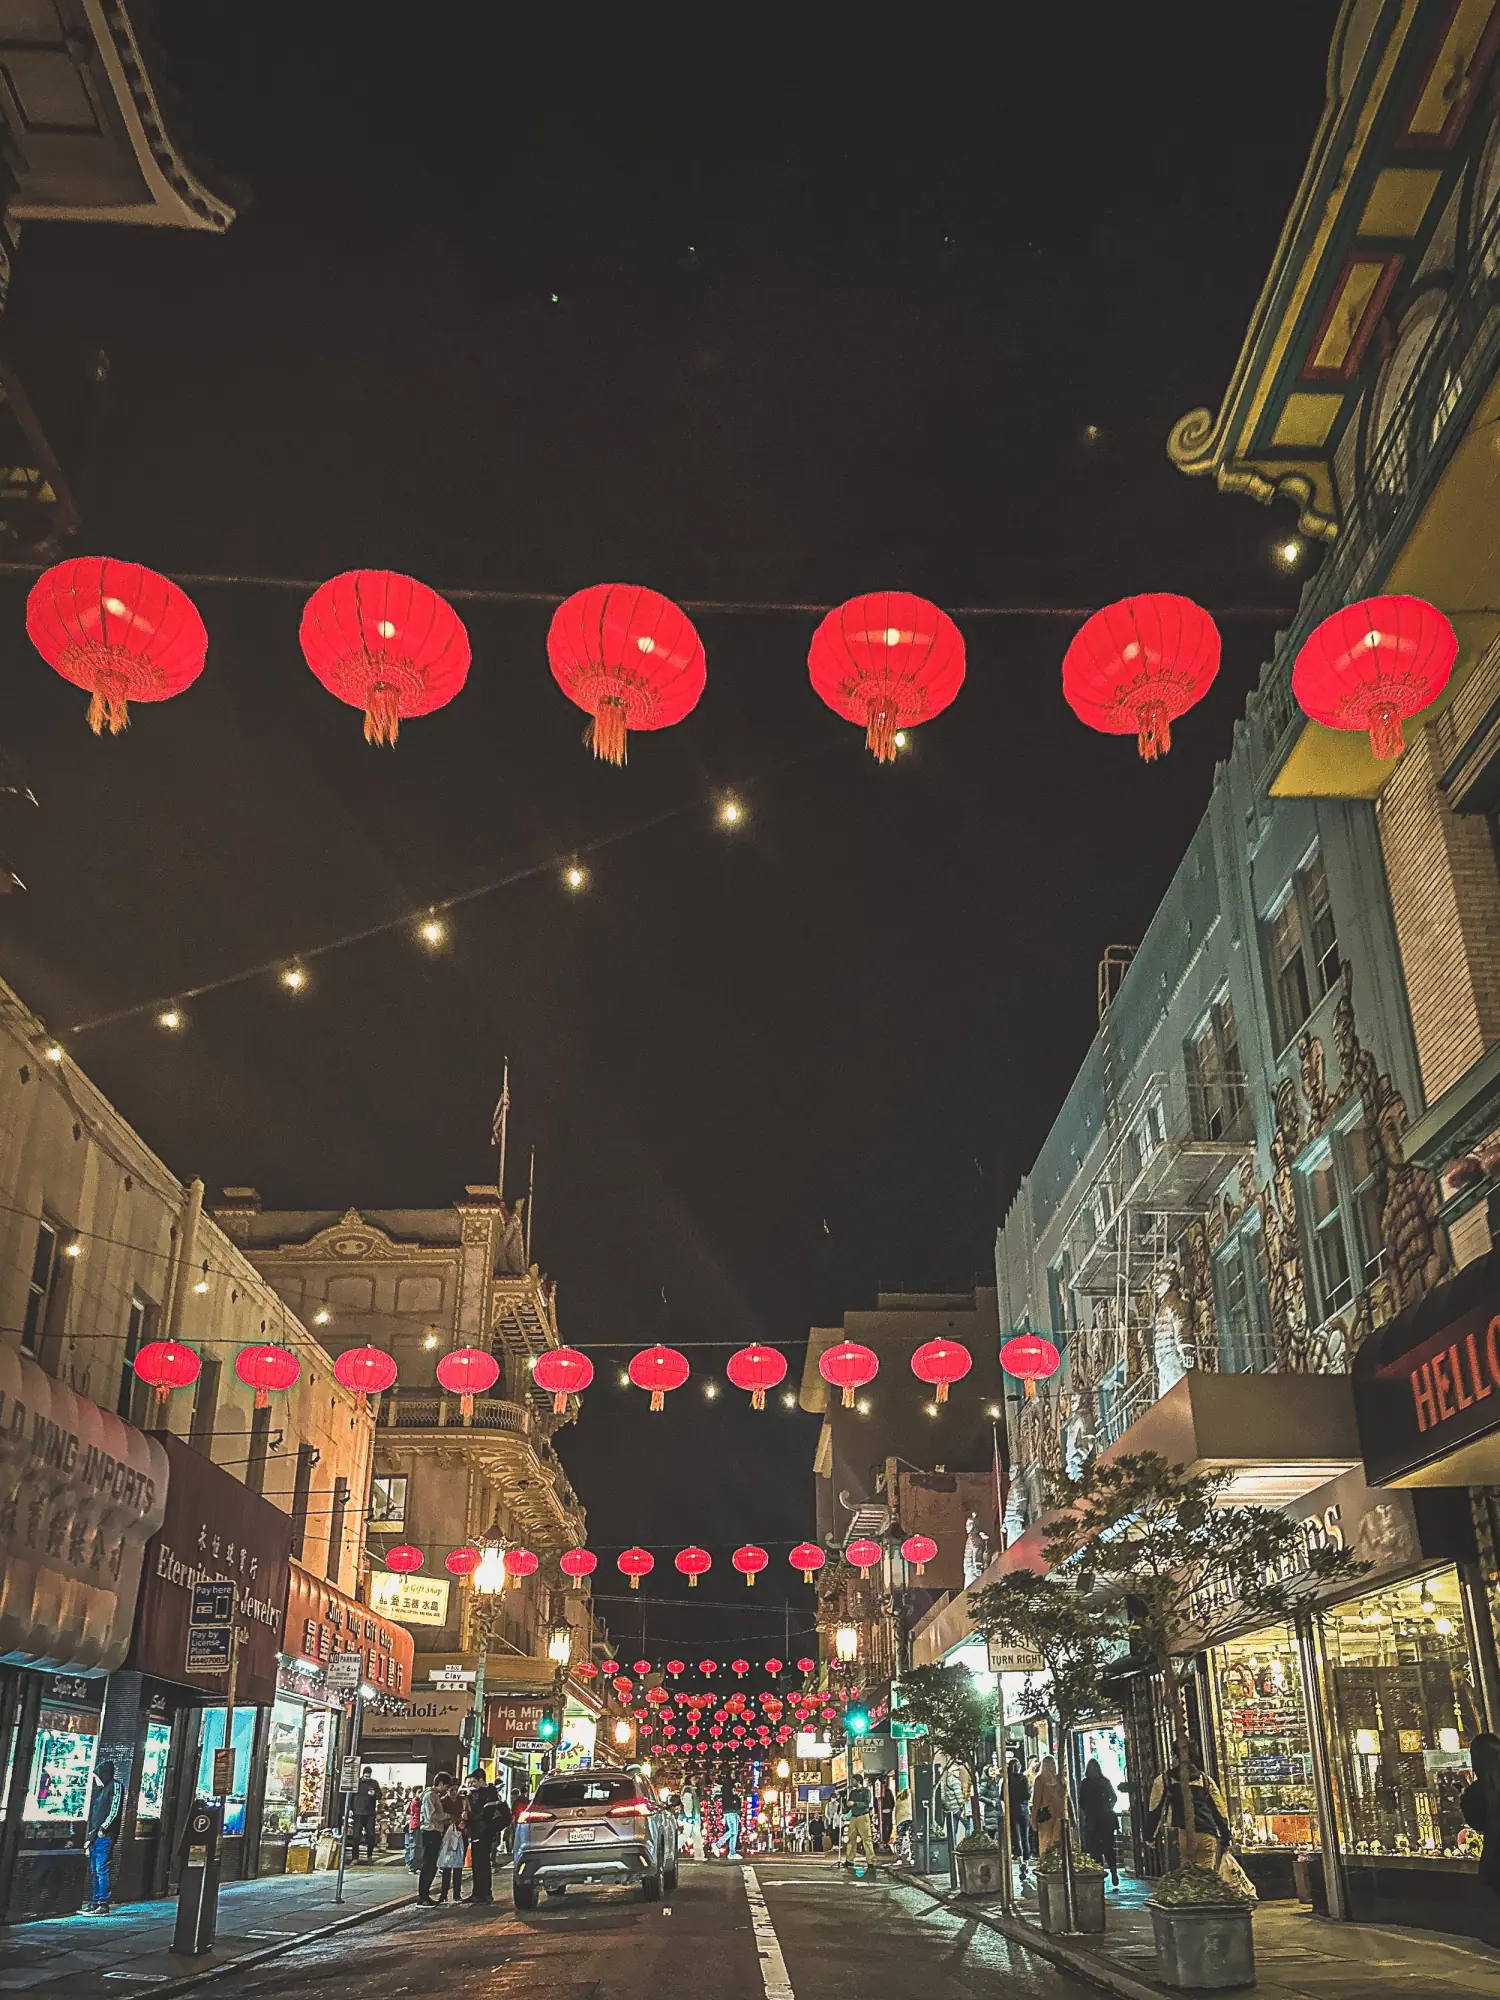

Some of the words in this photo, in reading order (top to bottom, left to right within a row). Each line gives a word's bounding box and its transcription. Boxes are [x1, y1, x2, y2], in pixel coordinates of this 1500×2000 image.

[32, 1411, 80, 1474] WING
[156, 1543, 212, 1590] Eternit
[240, 1587, 281, 1634] Jewelry
[196, 1586, 212, 1596] Pay
[213, 1586, 232, 1594] here
[411, 1584, 424, 1593] Gift
[425, 1585, 443, 1597] Shop
[192, 1630, 206, 1639] Pay
[208, 1630, 219, 1639] by
[365, 1619, 378, 1642] Gift
[380, 1628, 393, 1654] Shop
[191, 1639, 220, 1647] License
[1001, 1635, 1030, 1648] MUST
[190, 1647, 211, 1655] Plate
[330, 1653, 339, 1662] NO
[992, 1655, 1013, 1665] TURN
[1017, 1655, 1041, 1664] RIGHT
[445, 1672, 461, 1680] Clay
[498, 1706, 516, 1718] Ha
[505, 1719, 538, 1731] Mart
